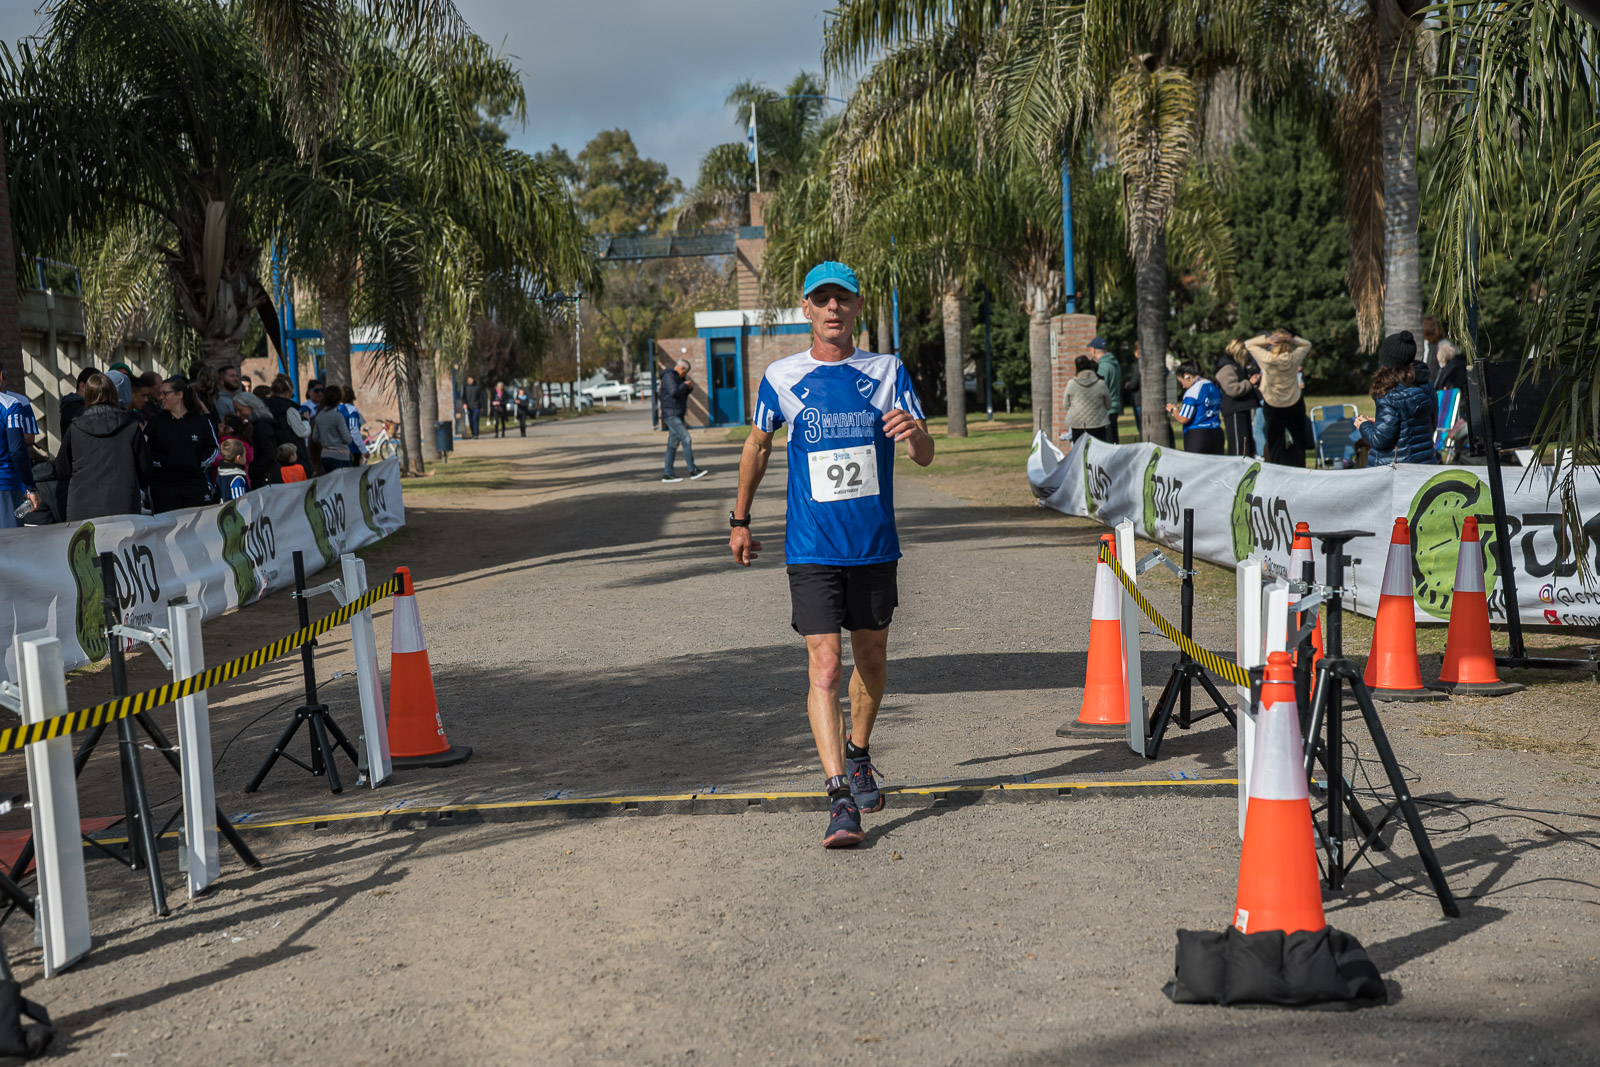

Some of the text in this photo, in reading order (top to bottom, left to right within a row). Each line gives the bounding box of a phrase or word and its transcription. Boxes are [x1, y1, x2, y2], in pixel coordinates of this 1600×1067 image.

[802, 407, 875, 443] 3 MARATÓN
[827, 462, 862, 488] 92
